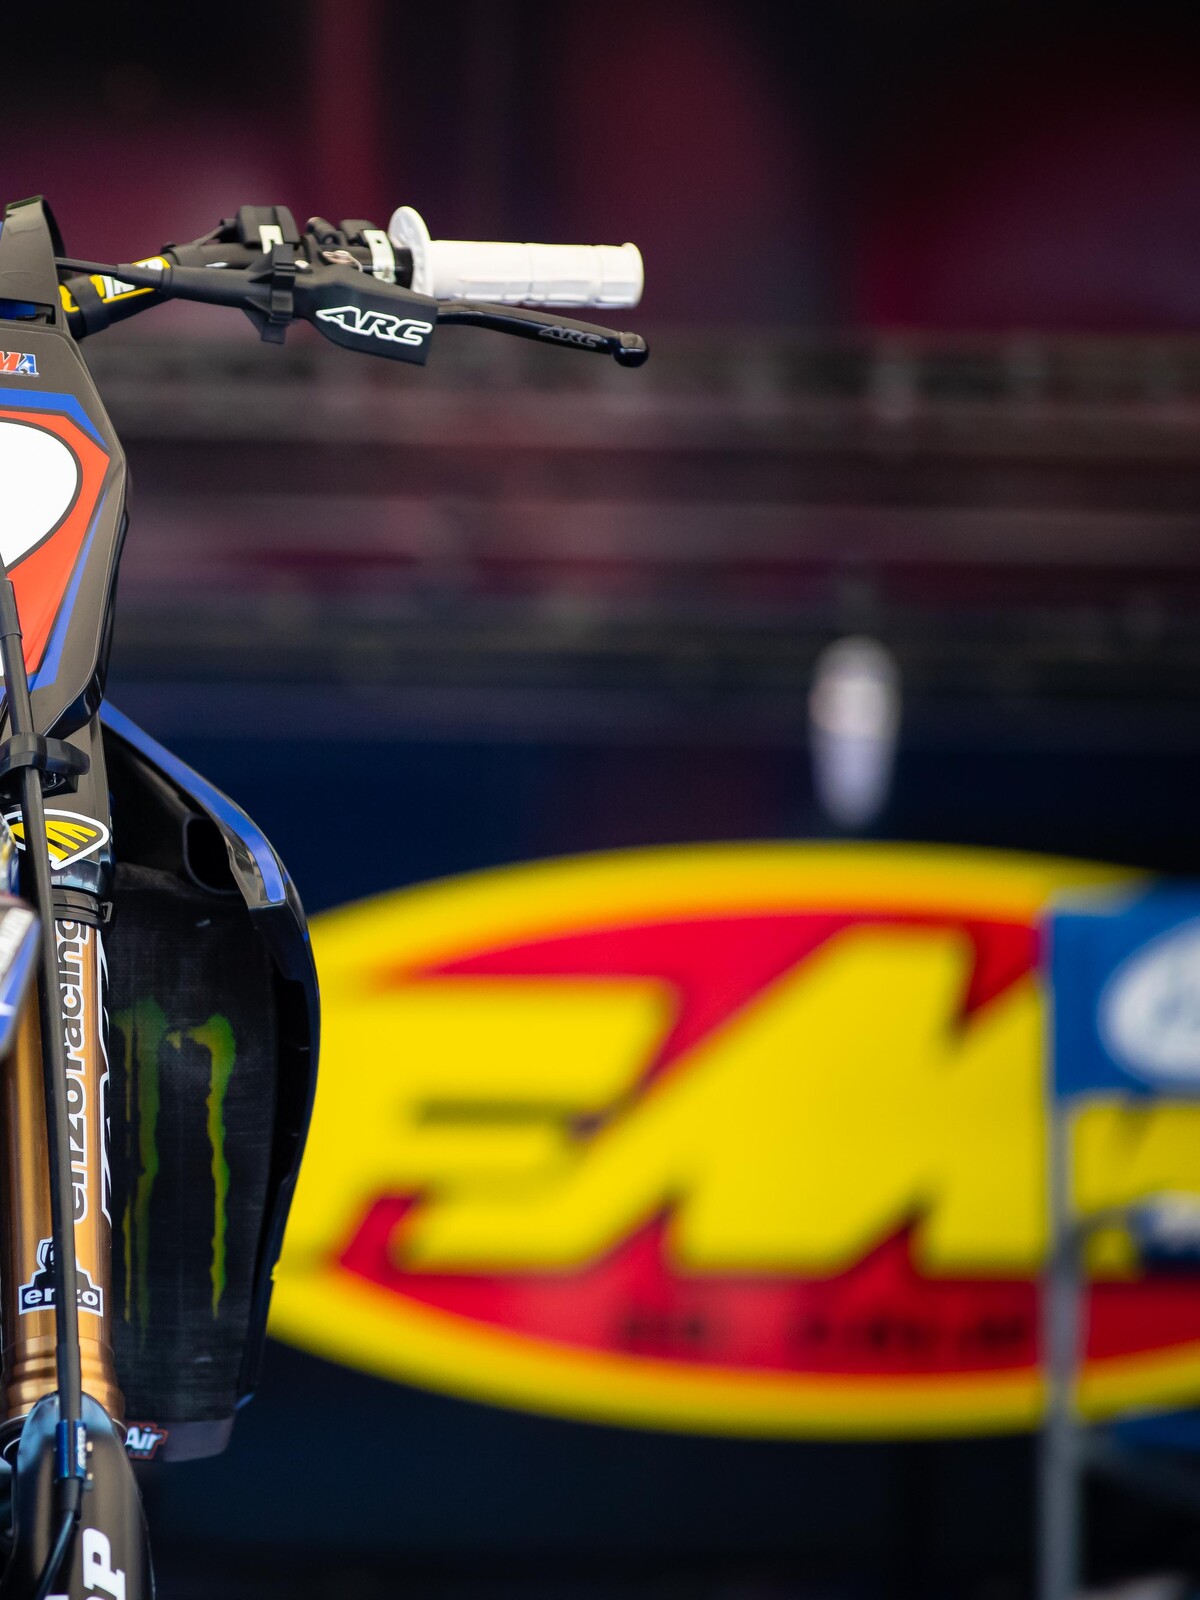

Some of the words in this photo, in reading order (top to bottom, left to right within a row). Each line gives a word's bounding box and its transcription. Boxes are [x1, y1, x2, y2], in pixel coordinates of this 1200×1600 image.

[315, 306, 433, 346] ARC
[538, 325, 602, 348] ARC
[125, 1427, 162, 1451] Air
